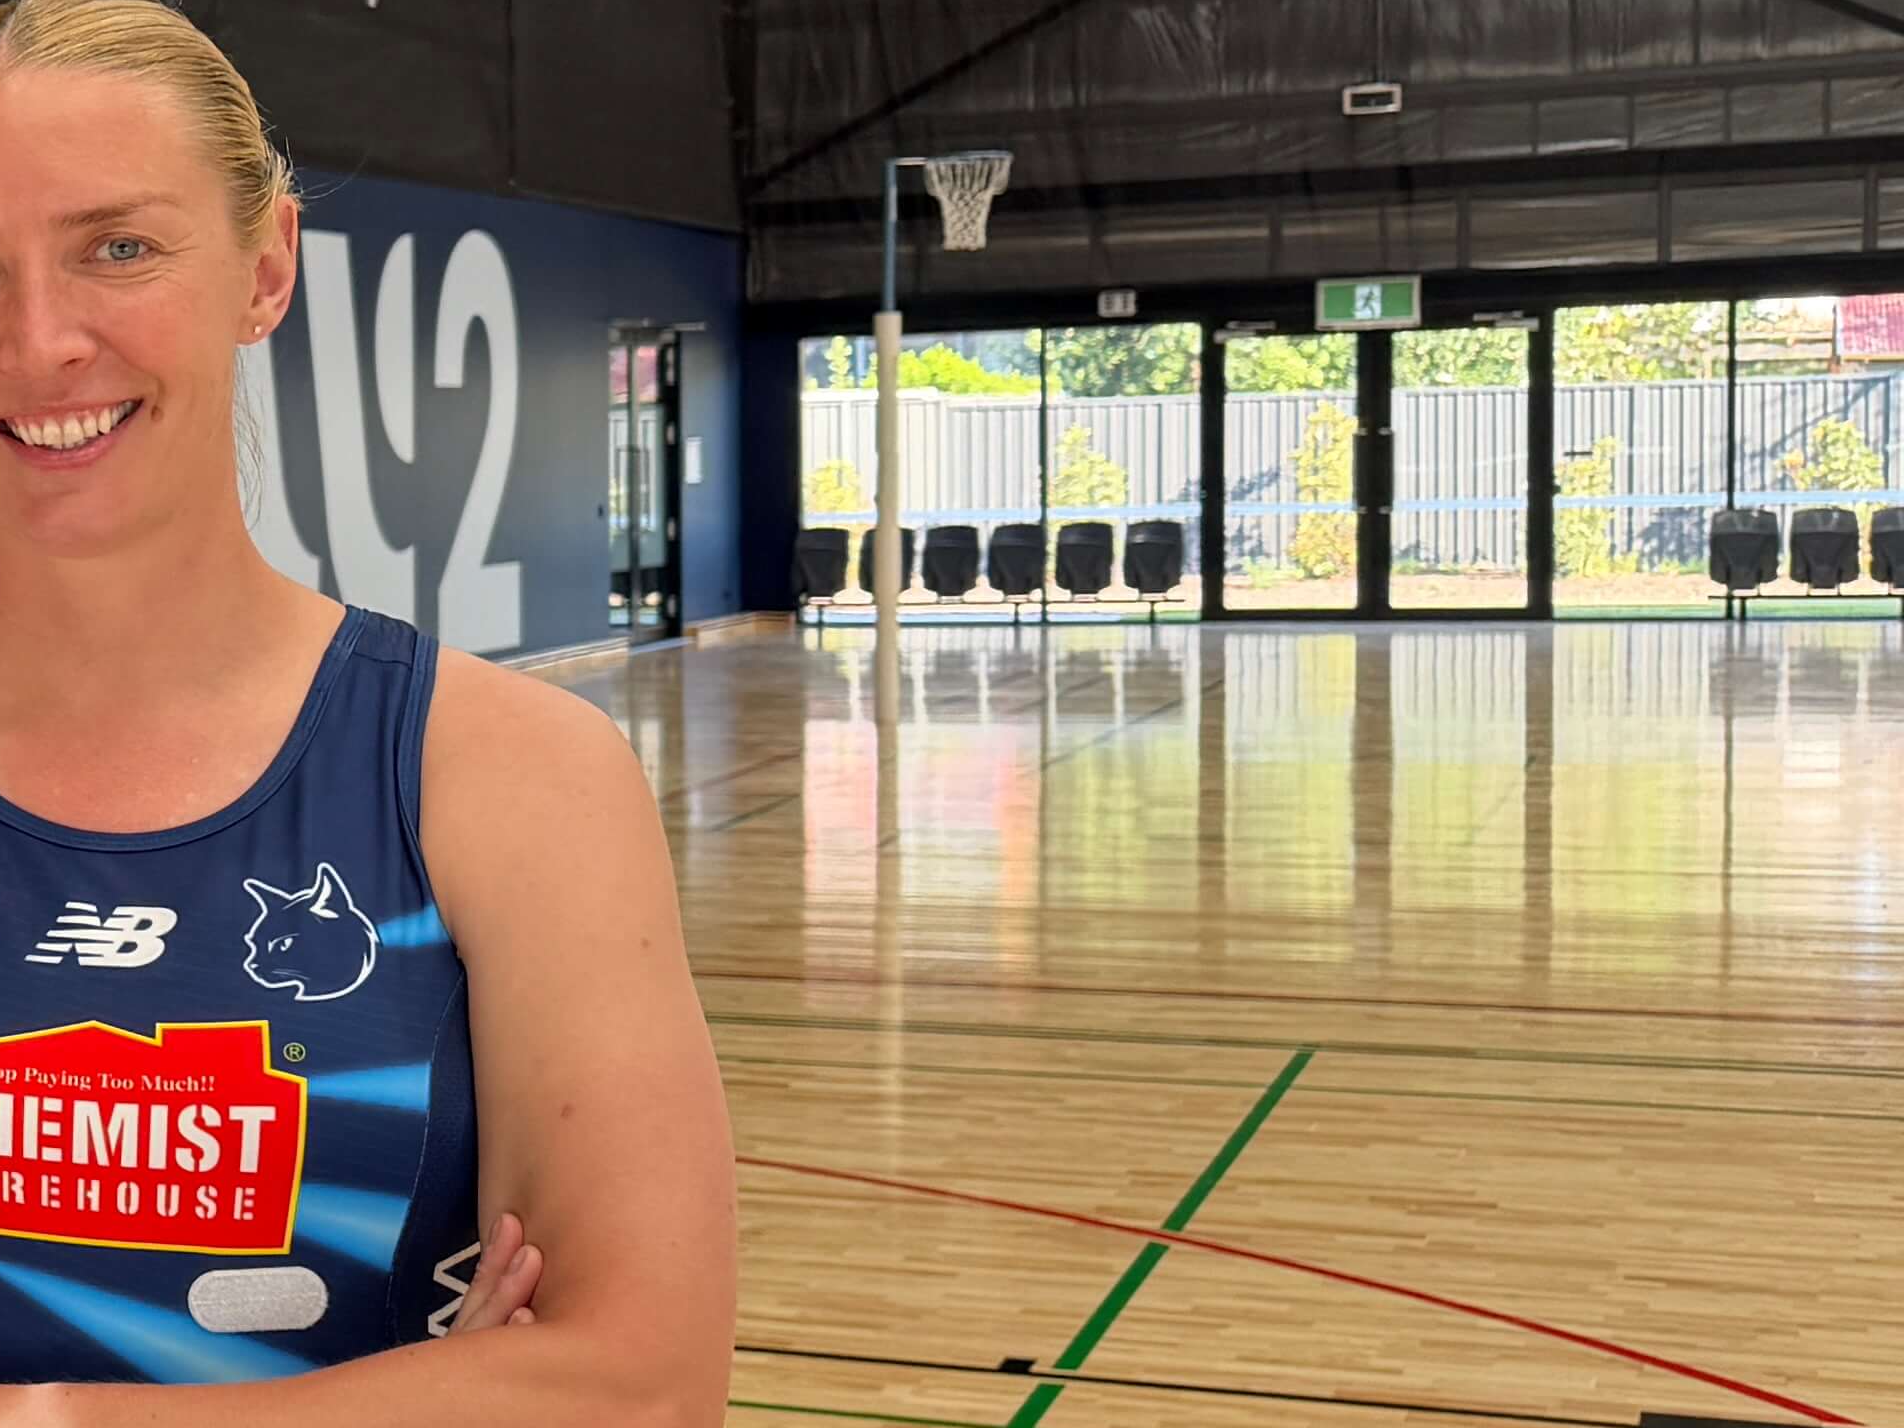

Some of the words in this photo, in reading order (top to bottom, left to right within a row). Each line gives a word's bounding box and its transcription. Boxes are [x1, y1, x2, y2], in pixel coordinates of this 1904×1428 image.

[24, 1067, 92, 1090] Paying
[97, 1073, 134, 1090] Too
[140, 1074, 216, 1093] Much!!
